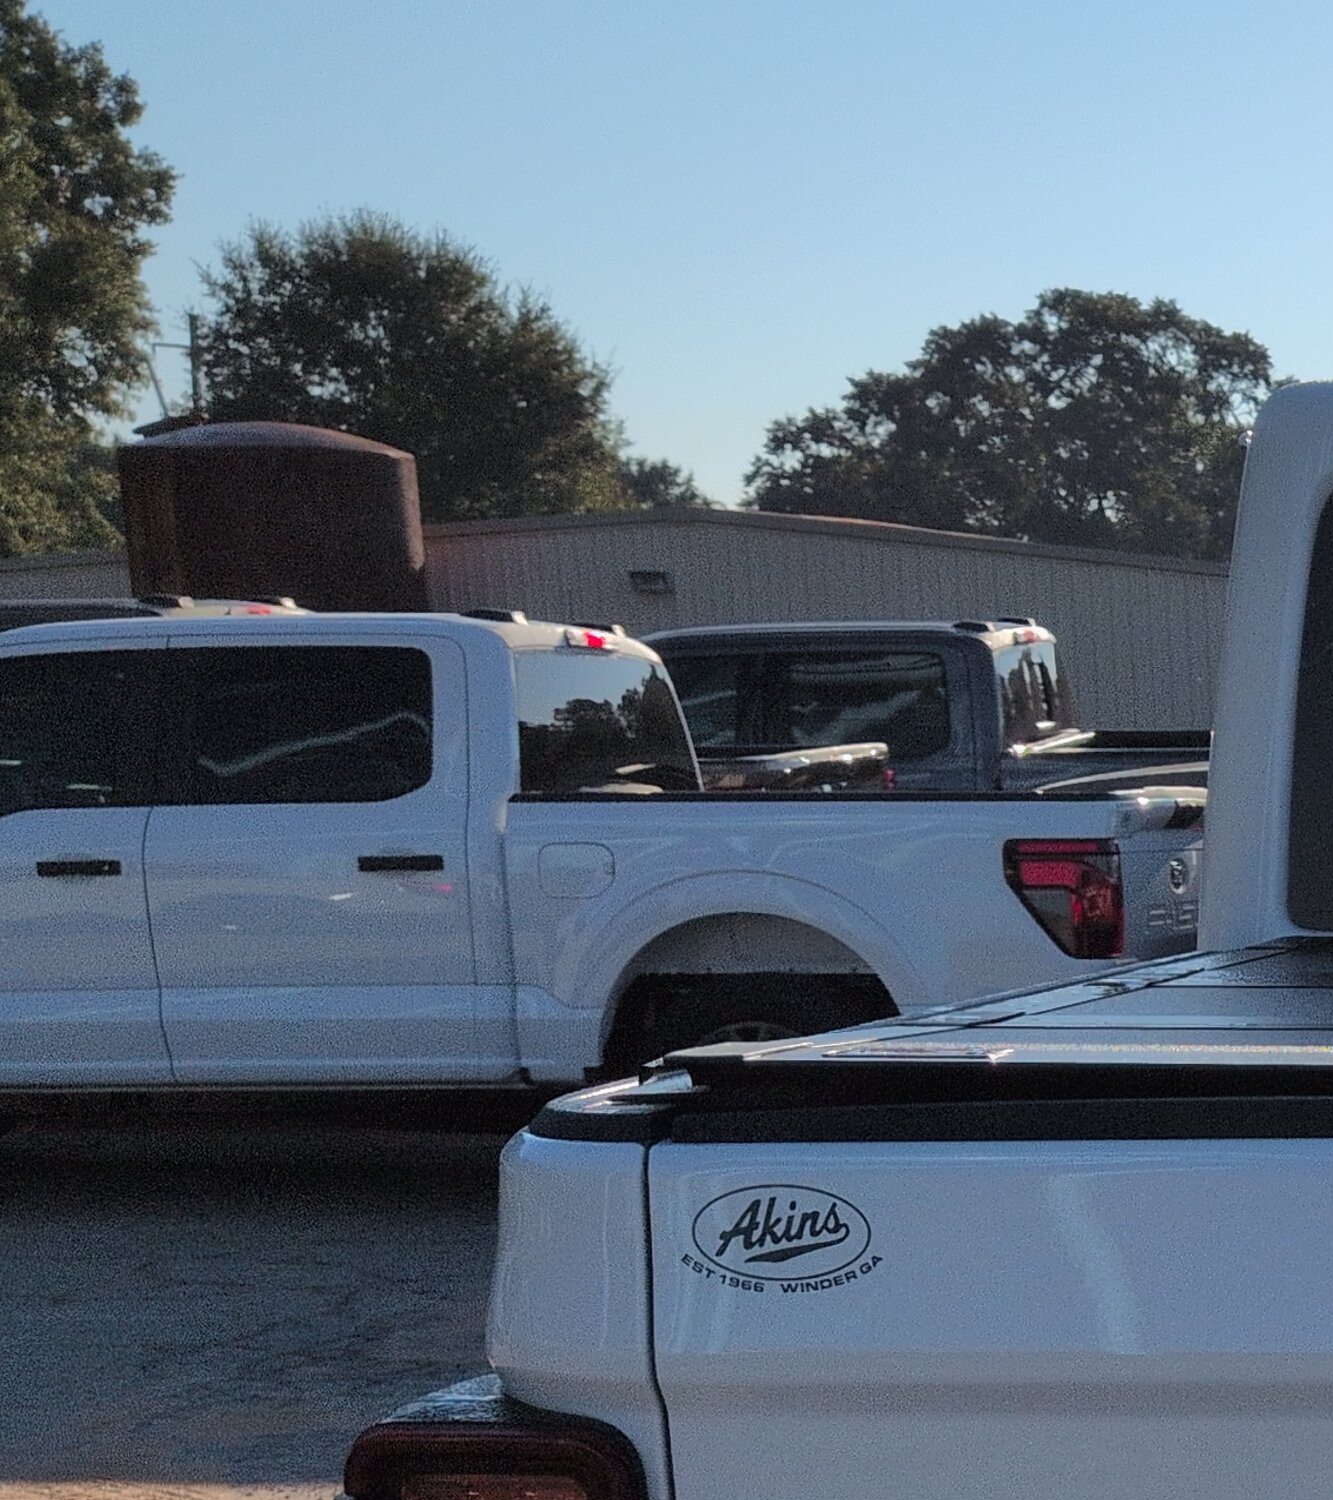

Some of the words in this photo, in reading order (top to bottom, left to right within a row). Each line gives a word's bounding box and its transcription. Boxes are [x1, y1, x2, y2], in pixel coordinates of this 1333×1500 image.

[715, 1196, 850, 1263] Akins
[681, 1253, 716, 1279] EST
[719, 1274, 765, 1293] 1966
[780, 1270, 858, 1294] WINDER
[859, 1255, 883, 1275] GA
